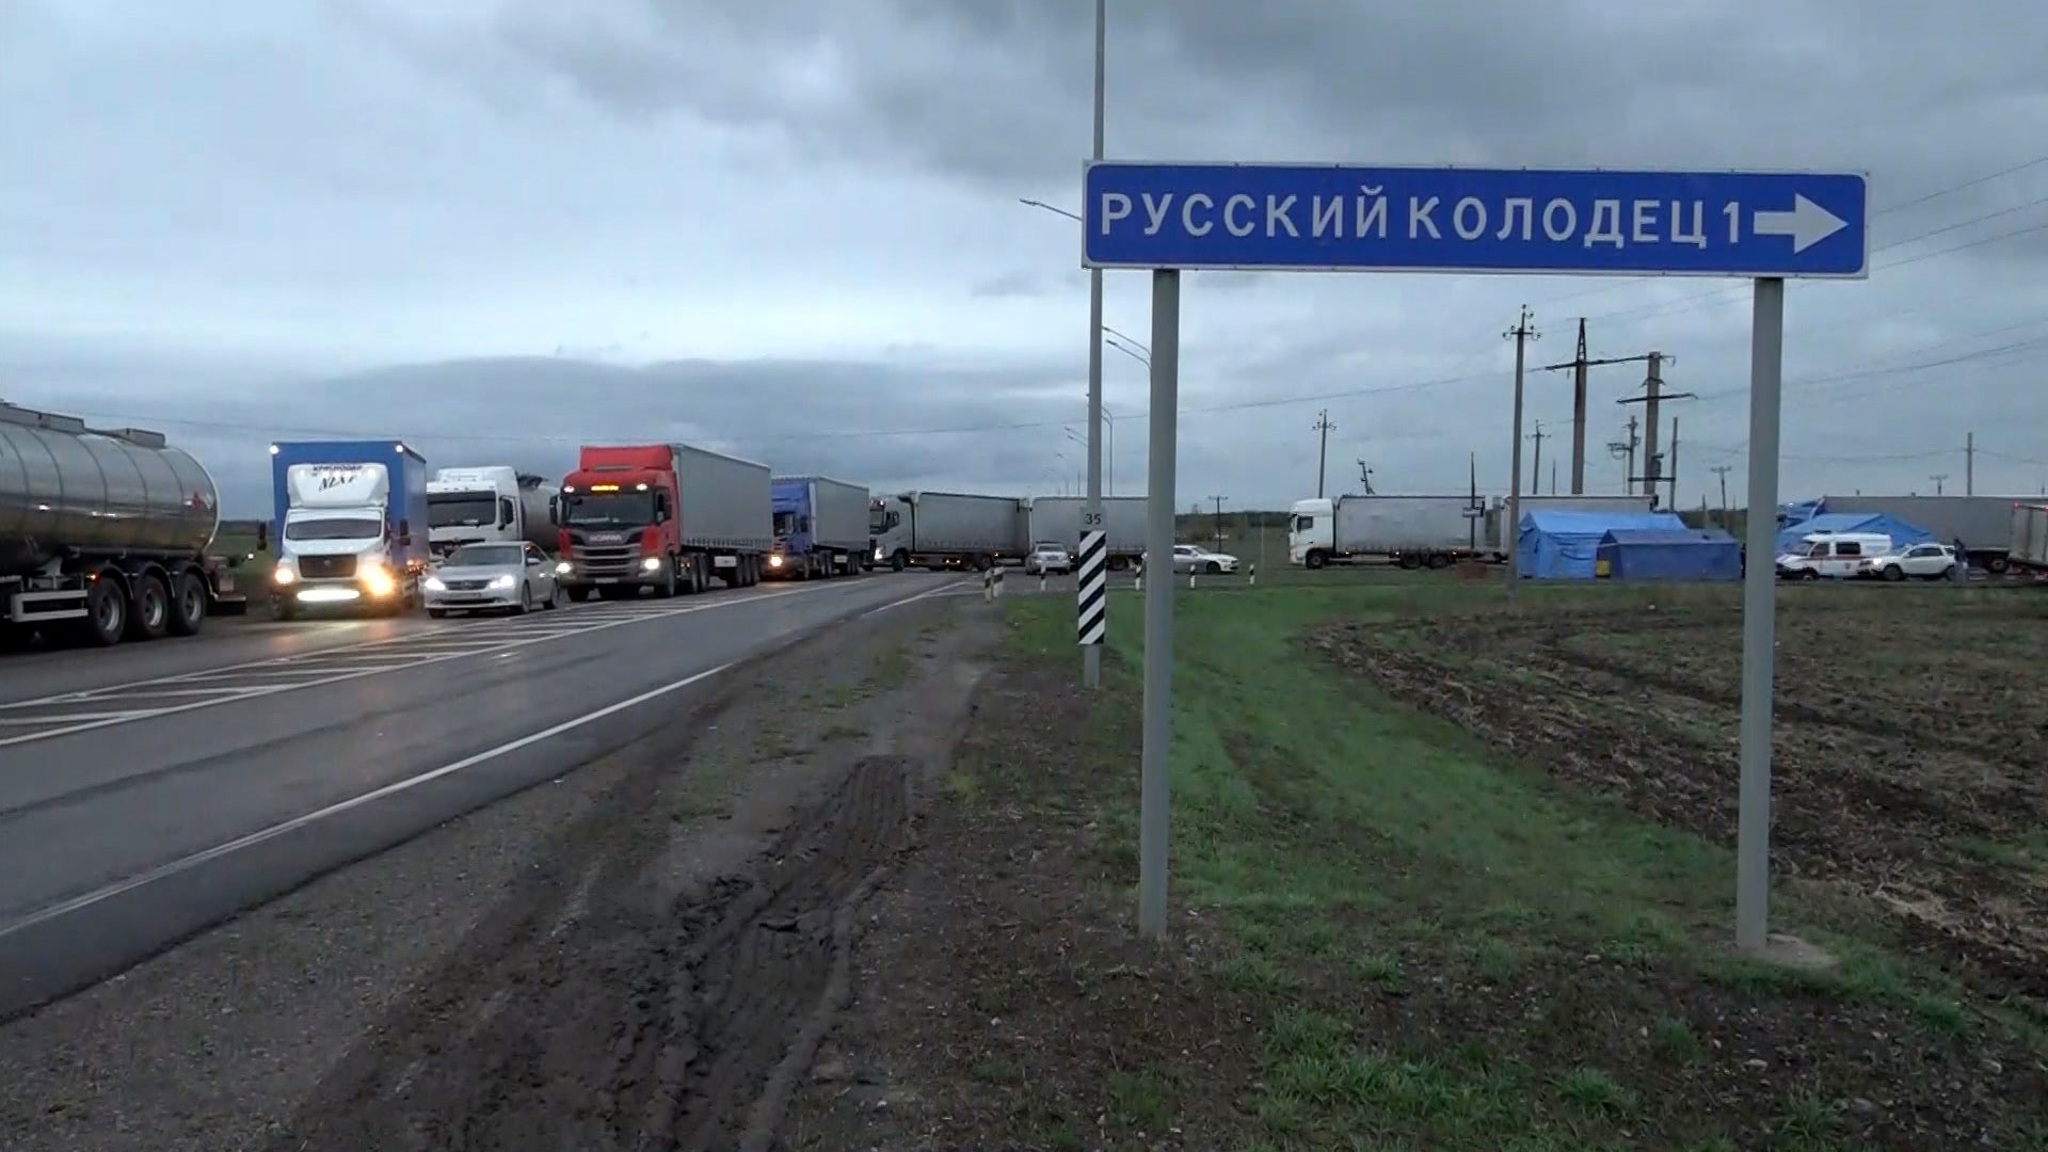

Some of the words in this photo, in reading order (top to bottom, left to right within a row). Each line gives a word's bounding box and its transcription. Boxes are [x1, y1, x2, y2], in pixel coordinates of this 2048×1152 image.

[1101, 184, 1387, 238] РУССКИЙ
[1409, 196, 1706, 248] КОЛОДЕЦ
[1723, 201, 1739, 243] 1
[1084, 512, 1102, 525] 35
